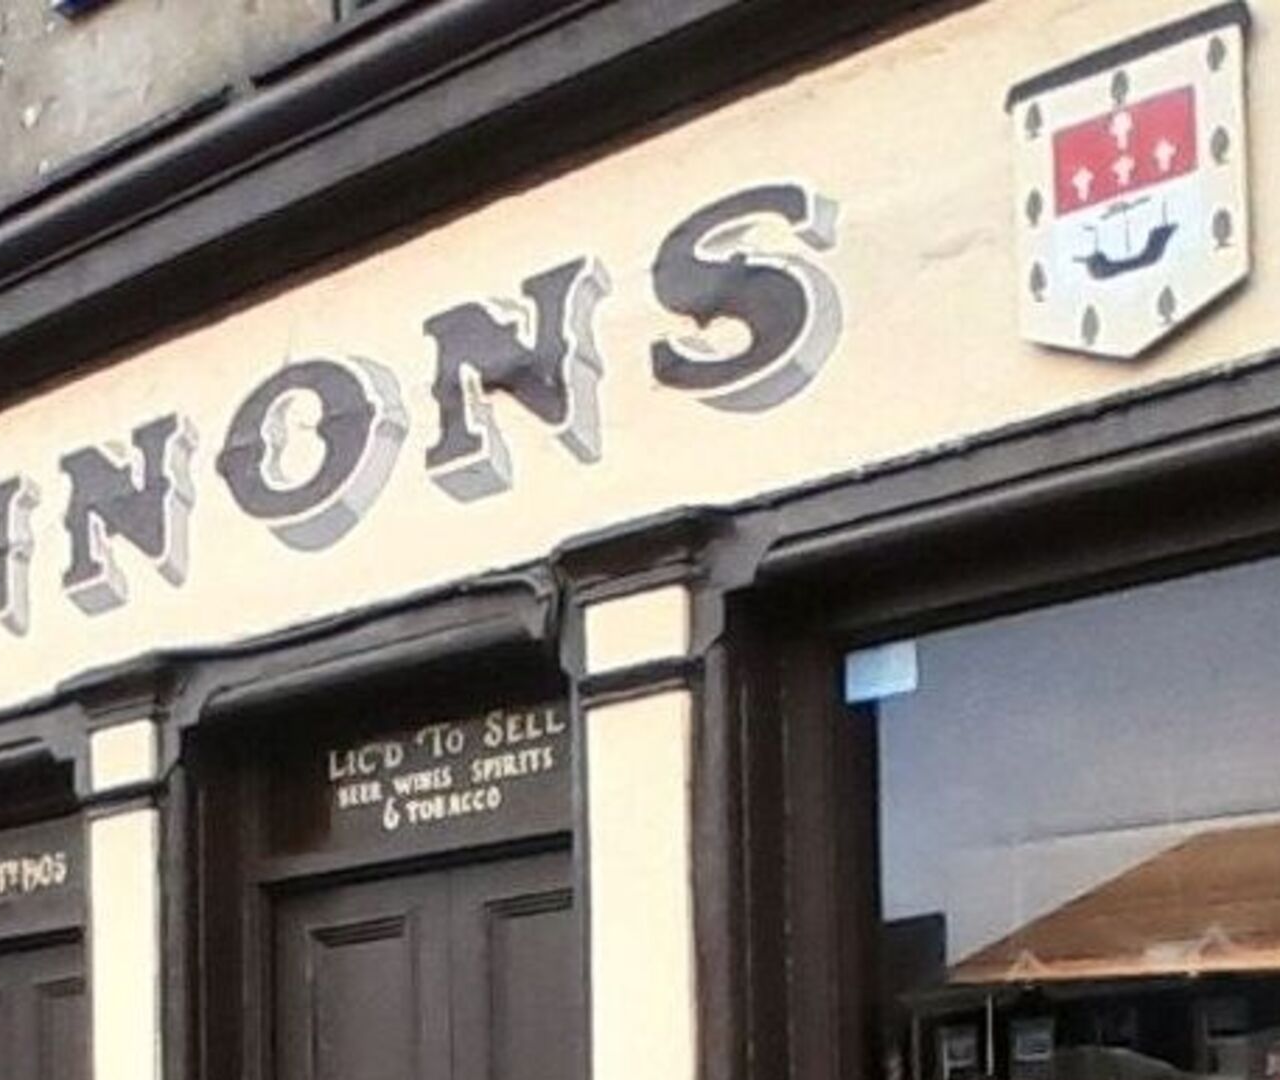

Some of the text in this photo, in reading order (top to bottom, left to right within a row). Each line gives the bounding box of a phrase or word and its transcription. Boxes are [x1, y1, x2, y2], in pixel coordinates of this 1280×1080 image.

[484, 709, 566, 747] SELL
[338, 746, 554, 808] BEER WINES SPIRITS
[406, 786, 503, 823] TOBACCO
